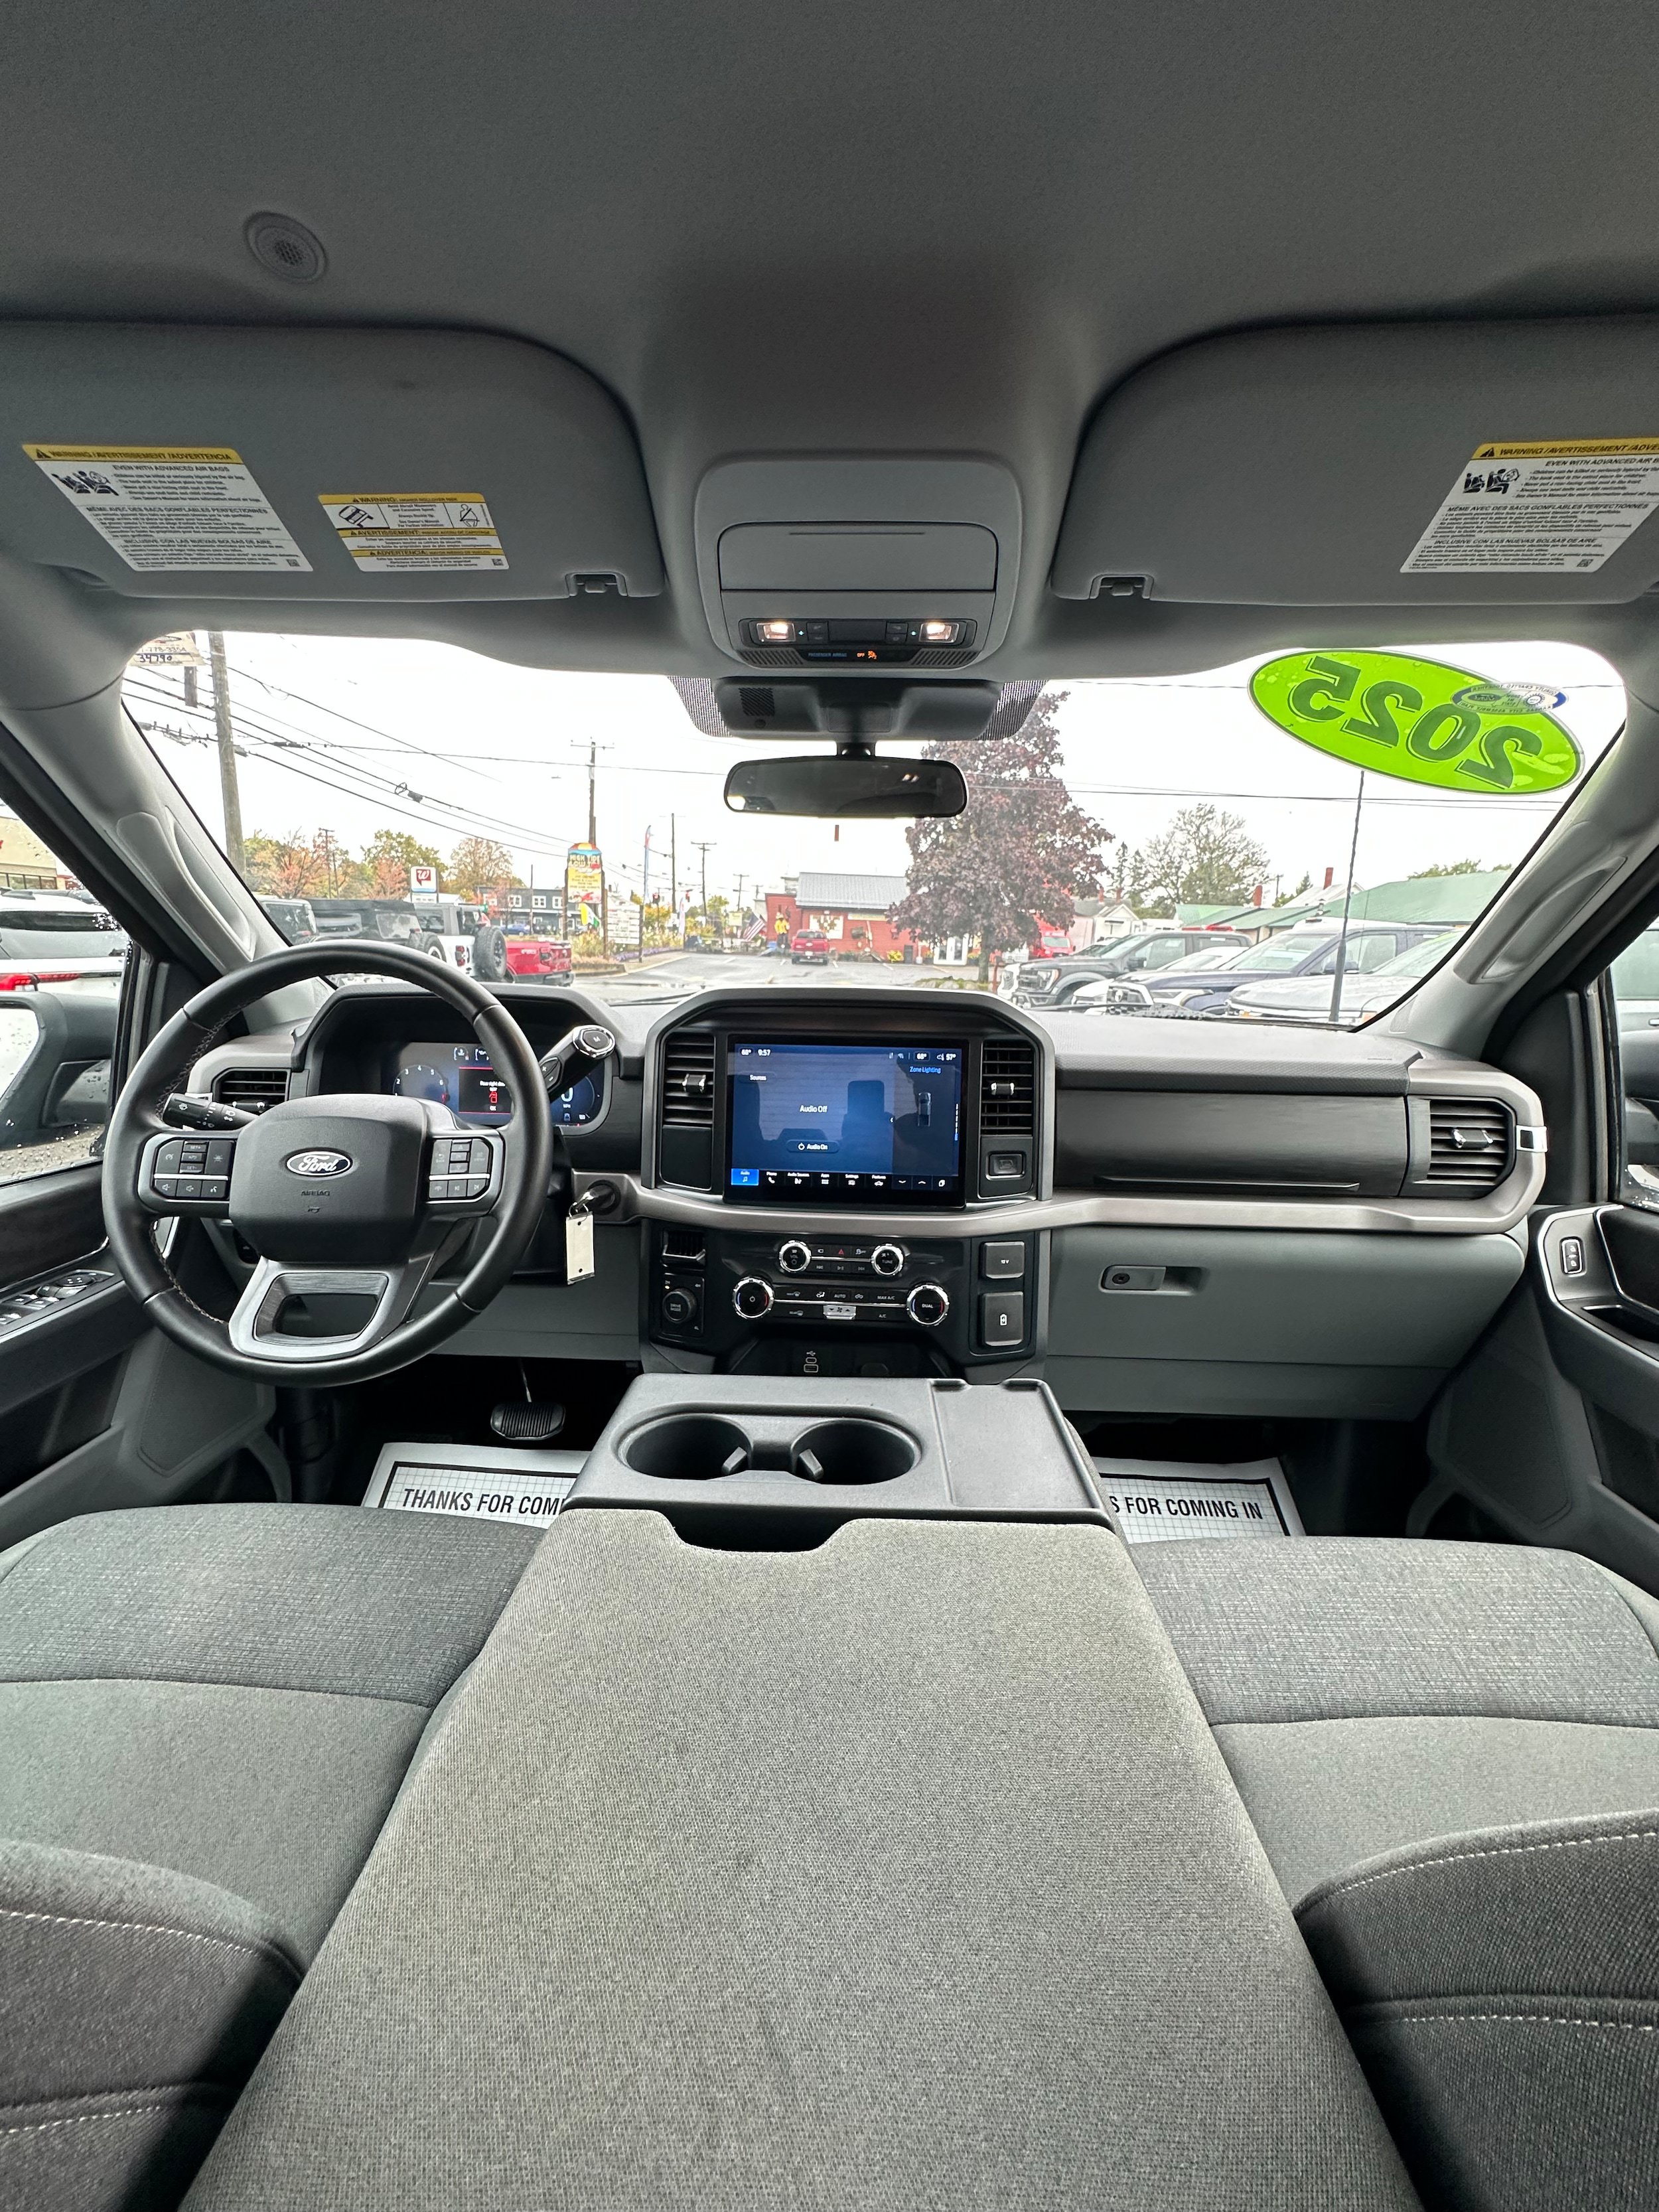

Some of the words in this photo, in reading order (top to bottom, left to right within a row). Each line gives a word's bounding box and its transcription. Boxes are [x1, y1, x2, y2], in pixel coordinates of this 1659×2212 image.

[299, 1155, 339, 1172] Ford
[403, 1488, 473, 1511] THANKS
[476, 1493, 514, 1513] FOR
[1124, 1497, 1162, 1515] FOR
[1166, 1499, 1239, 1518] COMING
[1242, 1501, 1263, 1520] IN
